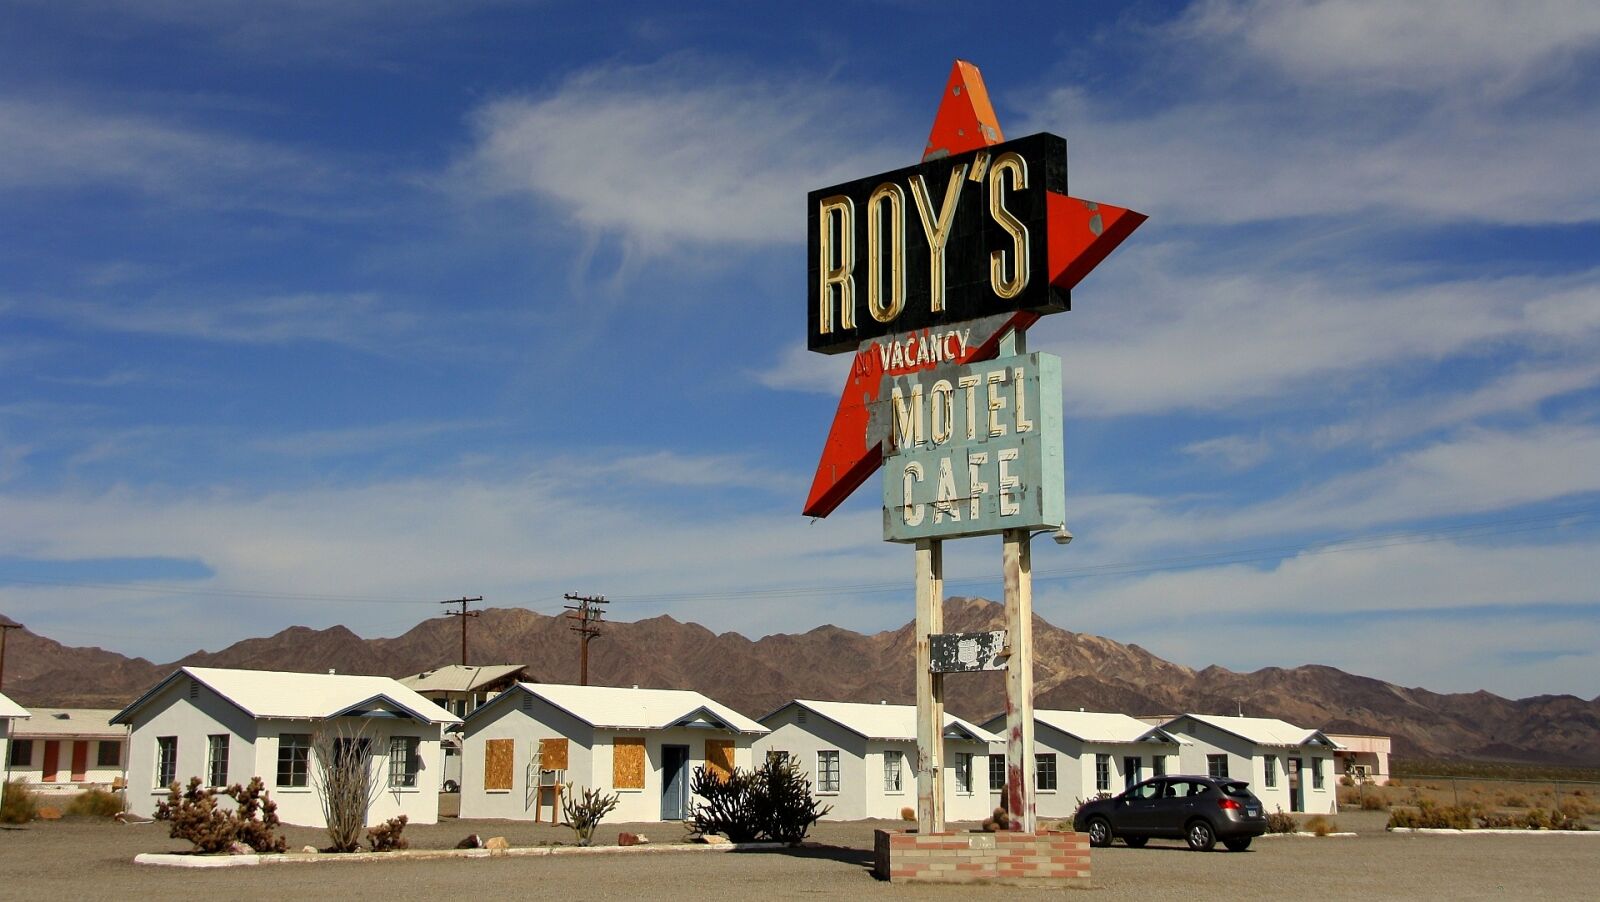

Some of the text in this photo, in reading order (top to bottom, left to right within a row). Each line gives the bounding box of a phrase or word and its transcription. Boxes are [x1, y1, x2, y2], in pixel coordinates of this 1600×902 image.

[820, 151, 1029, 334] ROY'S
[880, 328, 970, 371] VACANCY
[891, 367, 1033, 449] MOTEL
[903, 448, 1020, 527] CAFE
